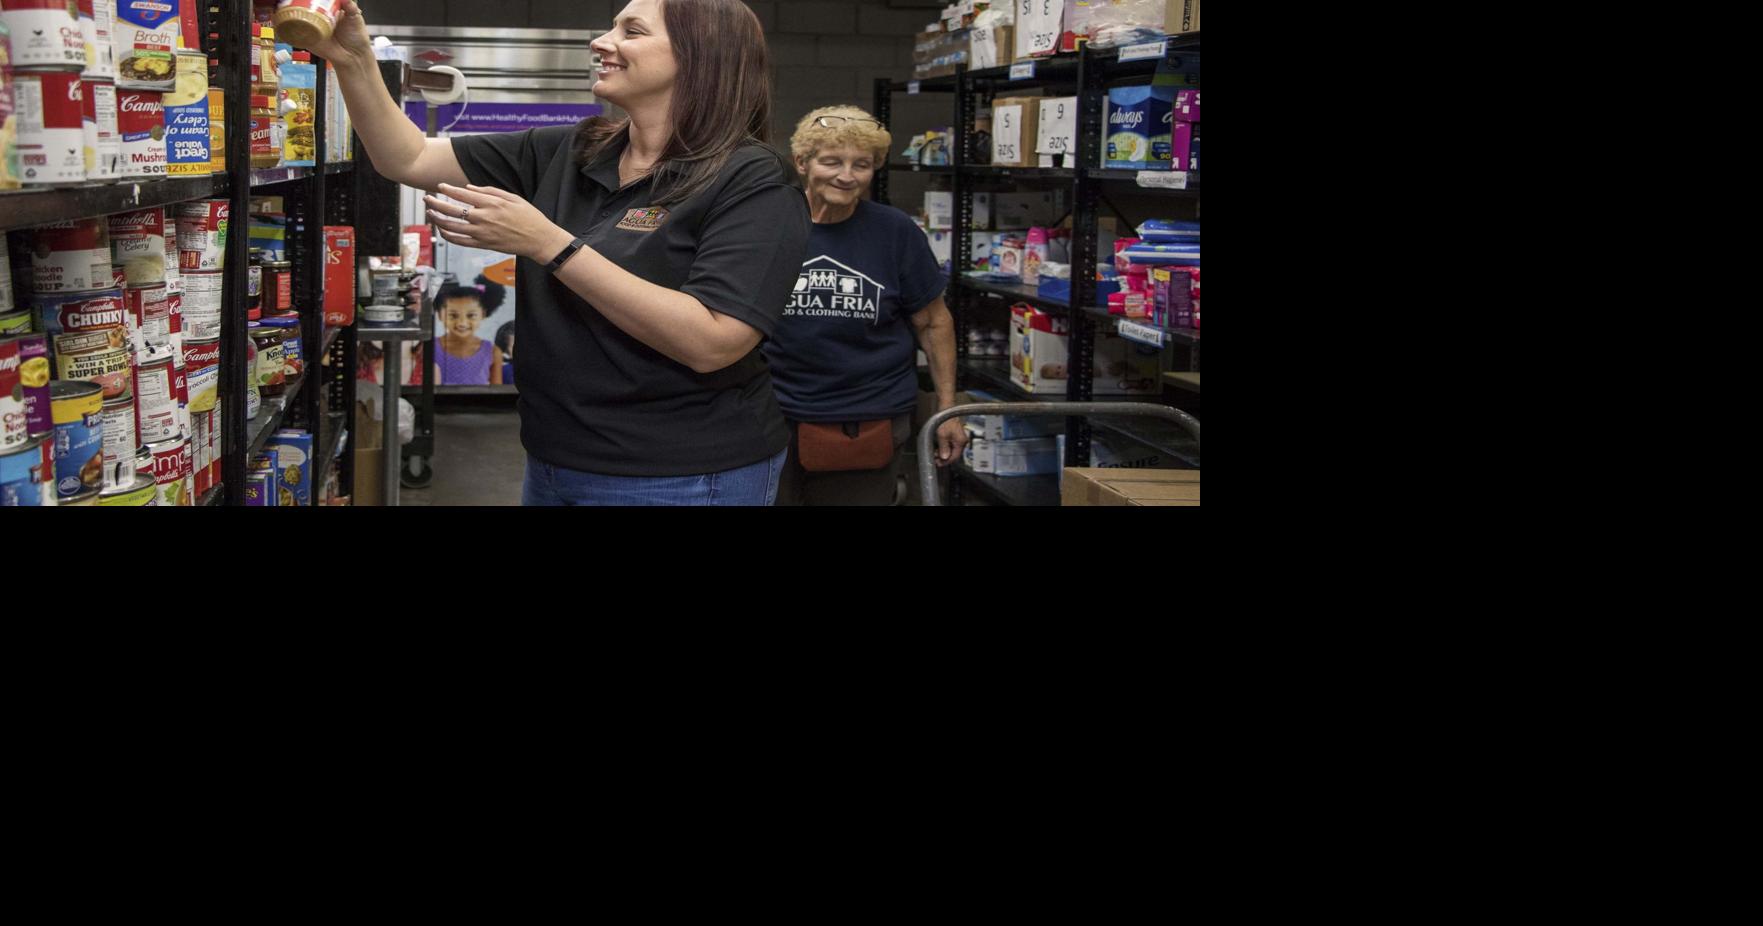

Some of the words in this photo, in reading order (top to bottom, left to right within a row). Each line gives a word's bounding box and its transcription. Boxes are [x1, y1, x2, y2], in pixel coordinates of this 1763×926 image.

[135, 30, 171, 43] Broth
[173, 113, 208, 127] Celery
[1110, 107, 1144, 128] always
[181, 127, 210, 137] Cream
[251, 128, 270, 140] eam
[174, 141, 203, 149] Value
[132, 153, 166, 163] Mushro
[175, 148, 208, 160] Great
[143, 165, 166, 174] SOU
[785, 294, 824, 309] GUA
[831, 295, 876, 311] FRIA
[67, 310, 123, 328] CHUNKY
[805, 308, 852, 318] CLOTHING
[854, 310, 876, 319] BANK
[76, 360, 97, 370] WIN
[98, 359, 105, 367] A
[68, 365, 105, 379] SUPER
[189, 375, 210, 391] roccoli
